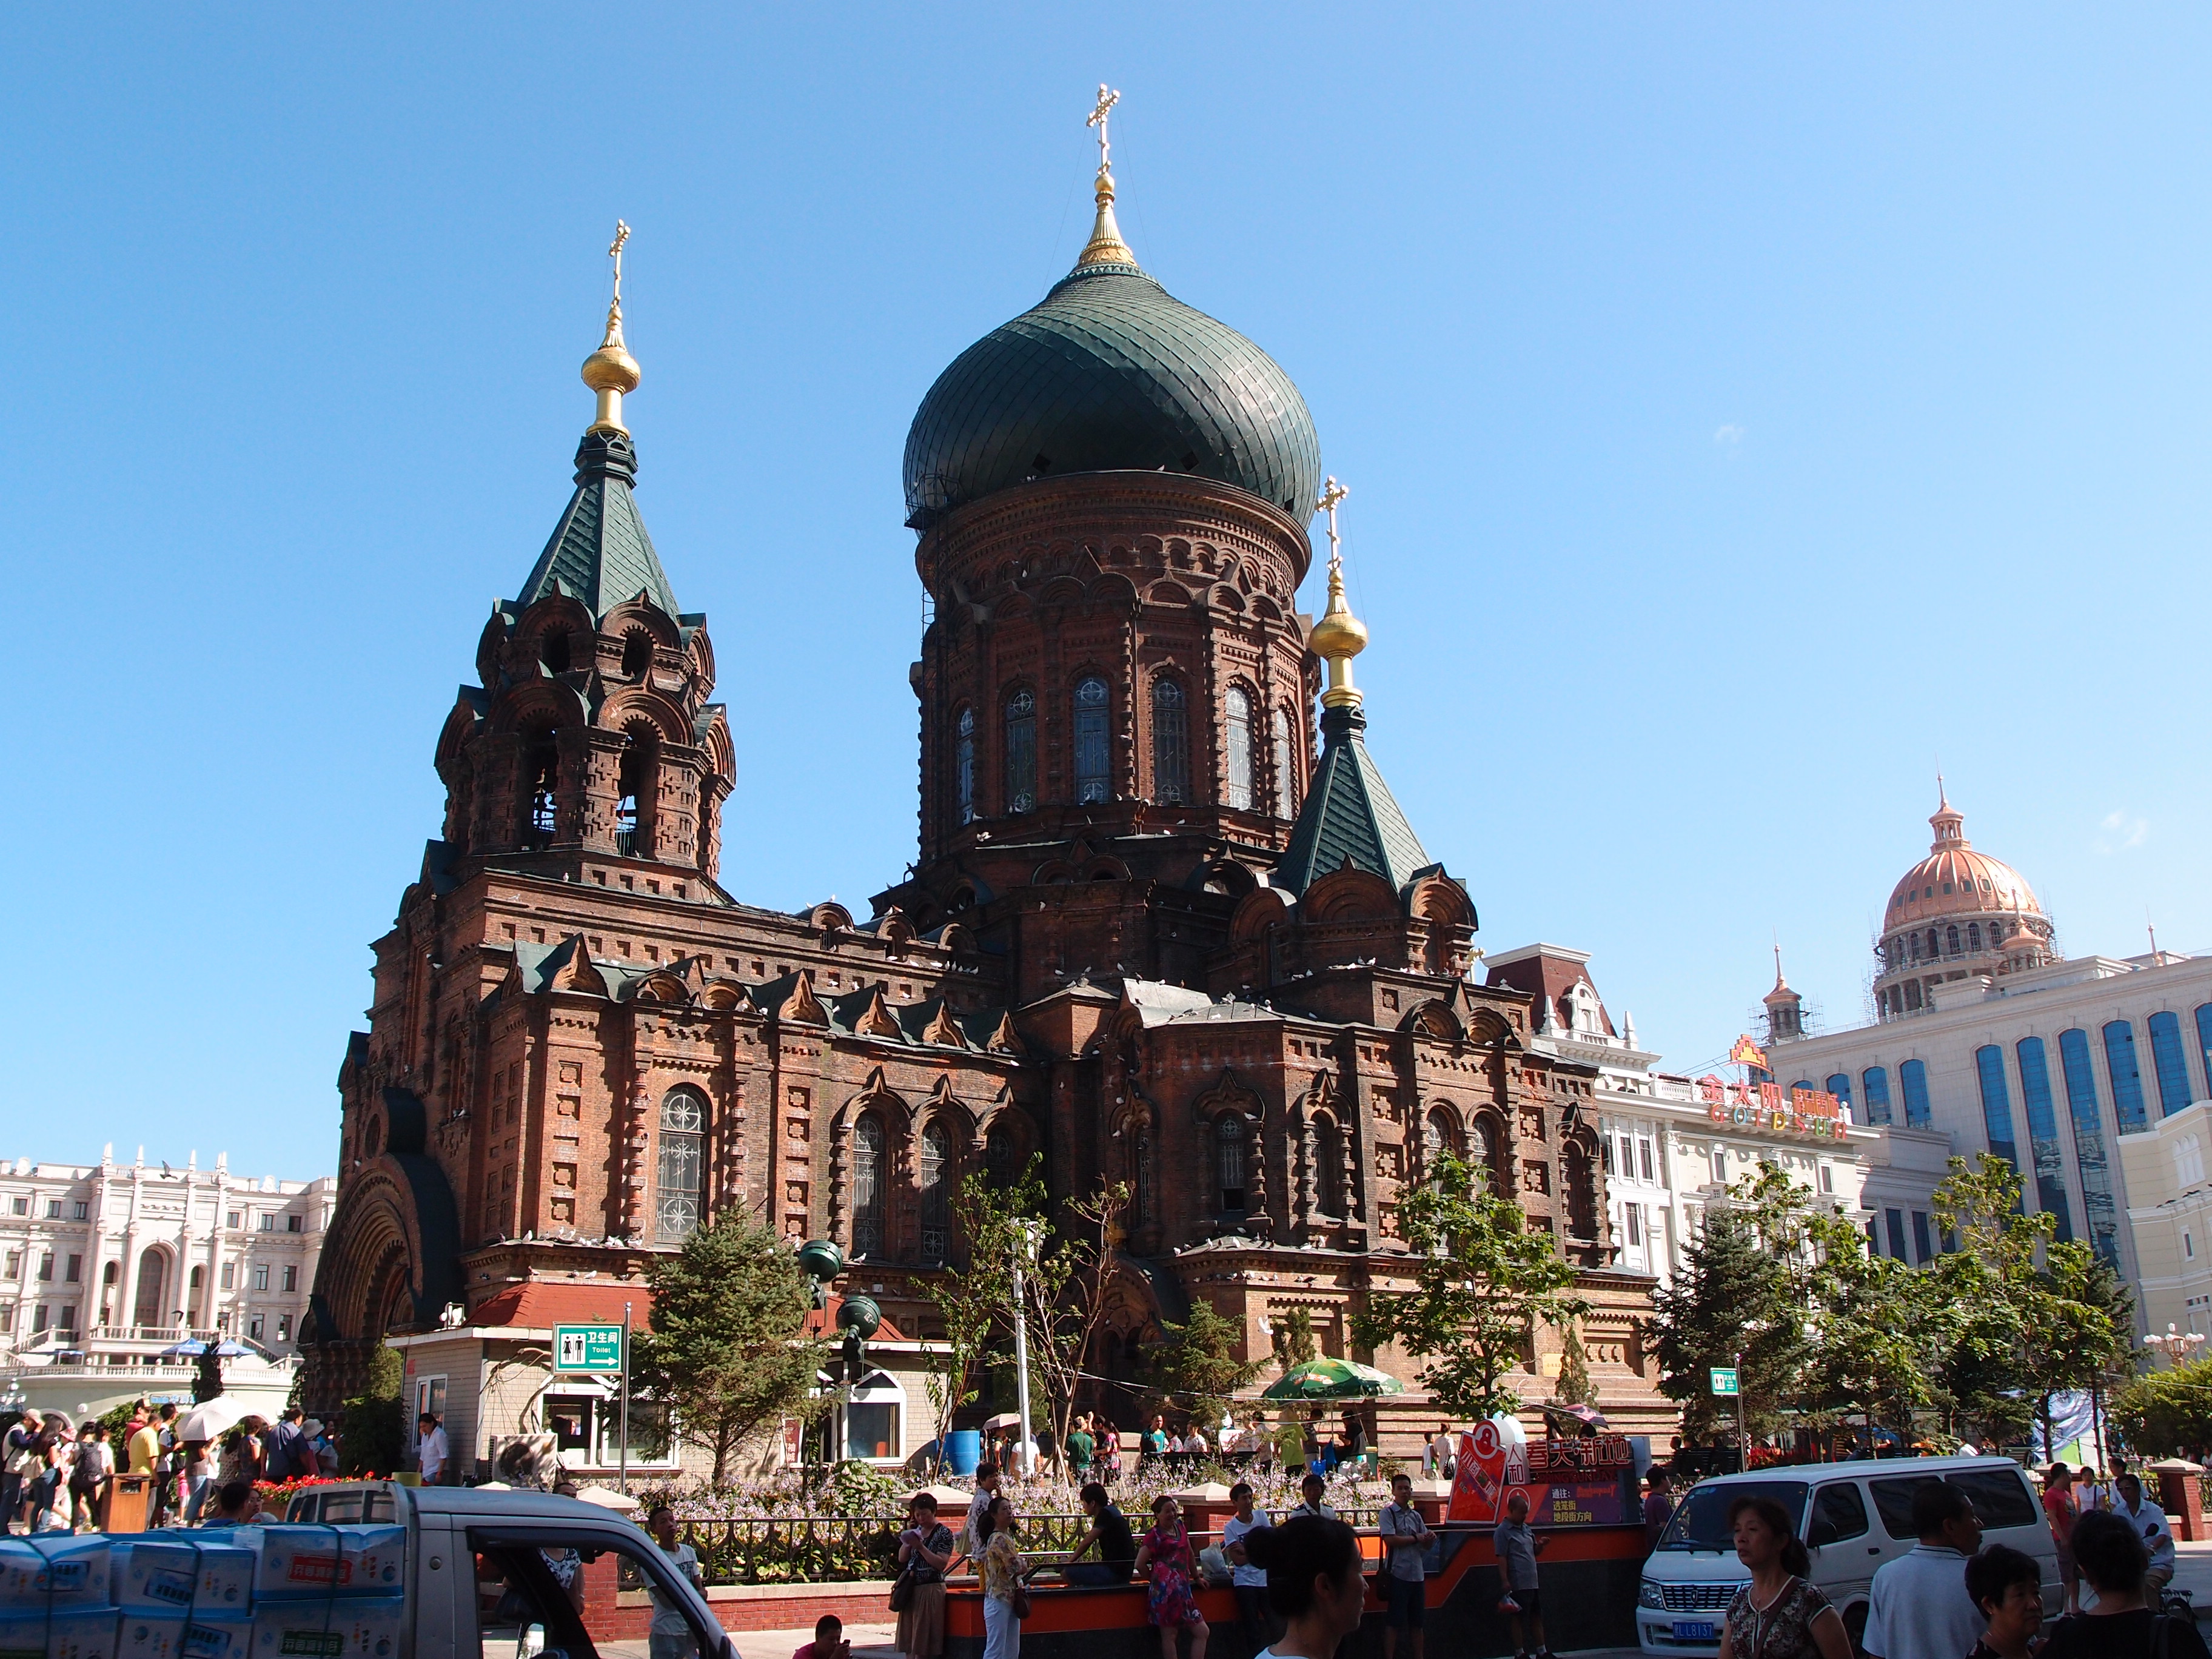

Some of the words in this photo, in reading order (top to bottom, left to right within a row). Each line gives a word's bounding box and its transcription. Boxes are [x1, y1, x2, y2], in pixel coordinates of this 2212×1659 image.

[1701, 1074, 1783, 1110] 金太阳
[587, 1332, 617, 1344] 卫生间
[1508, 1444, 1524, 1483] 人和
[1553, 1500, 1576, 1510] 透笼街
[1553, 1511, 1592, 1522] 地段街方向
